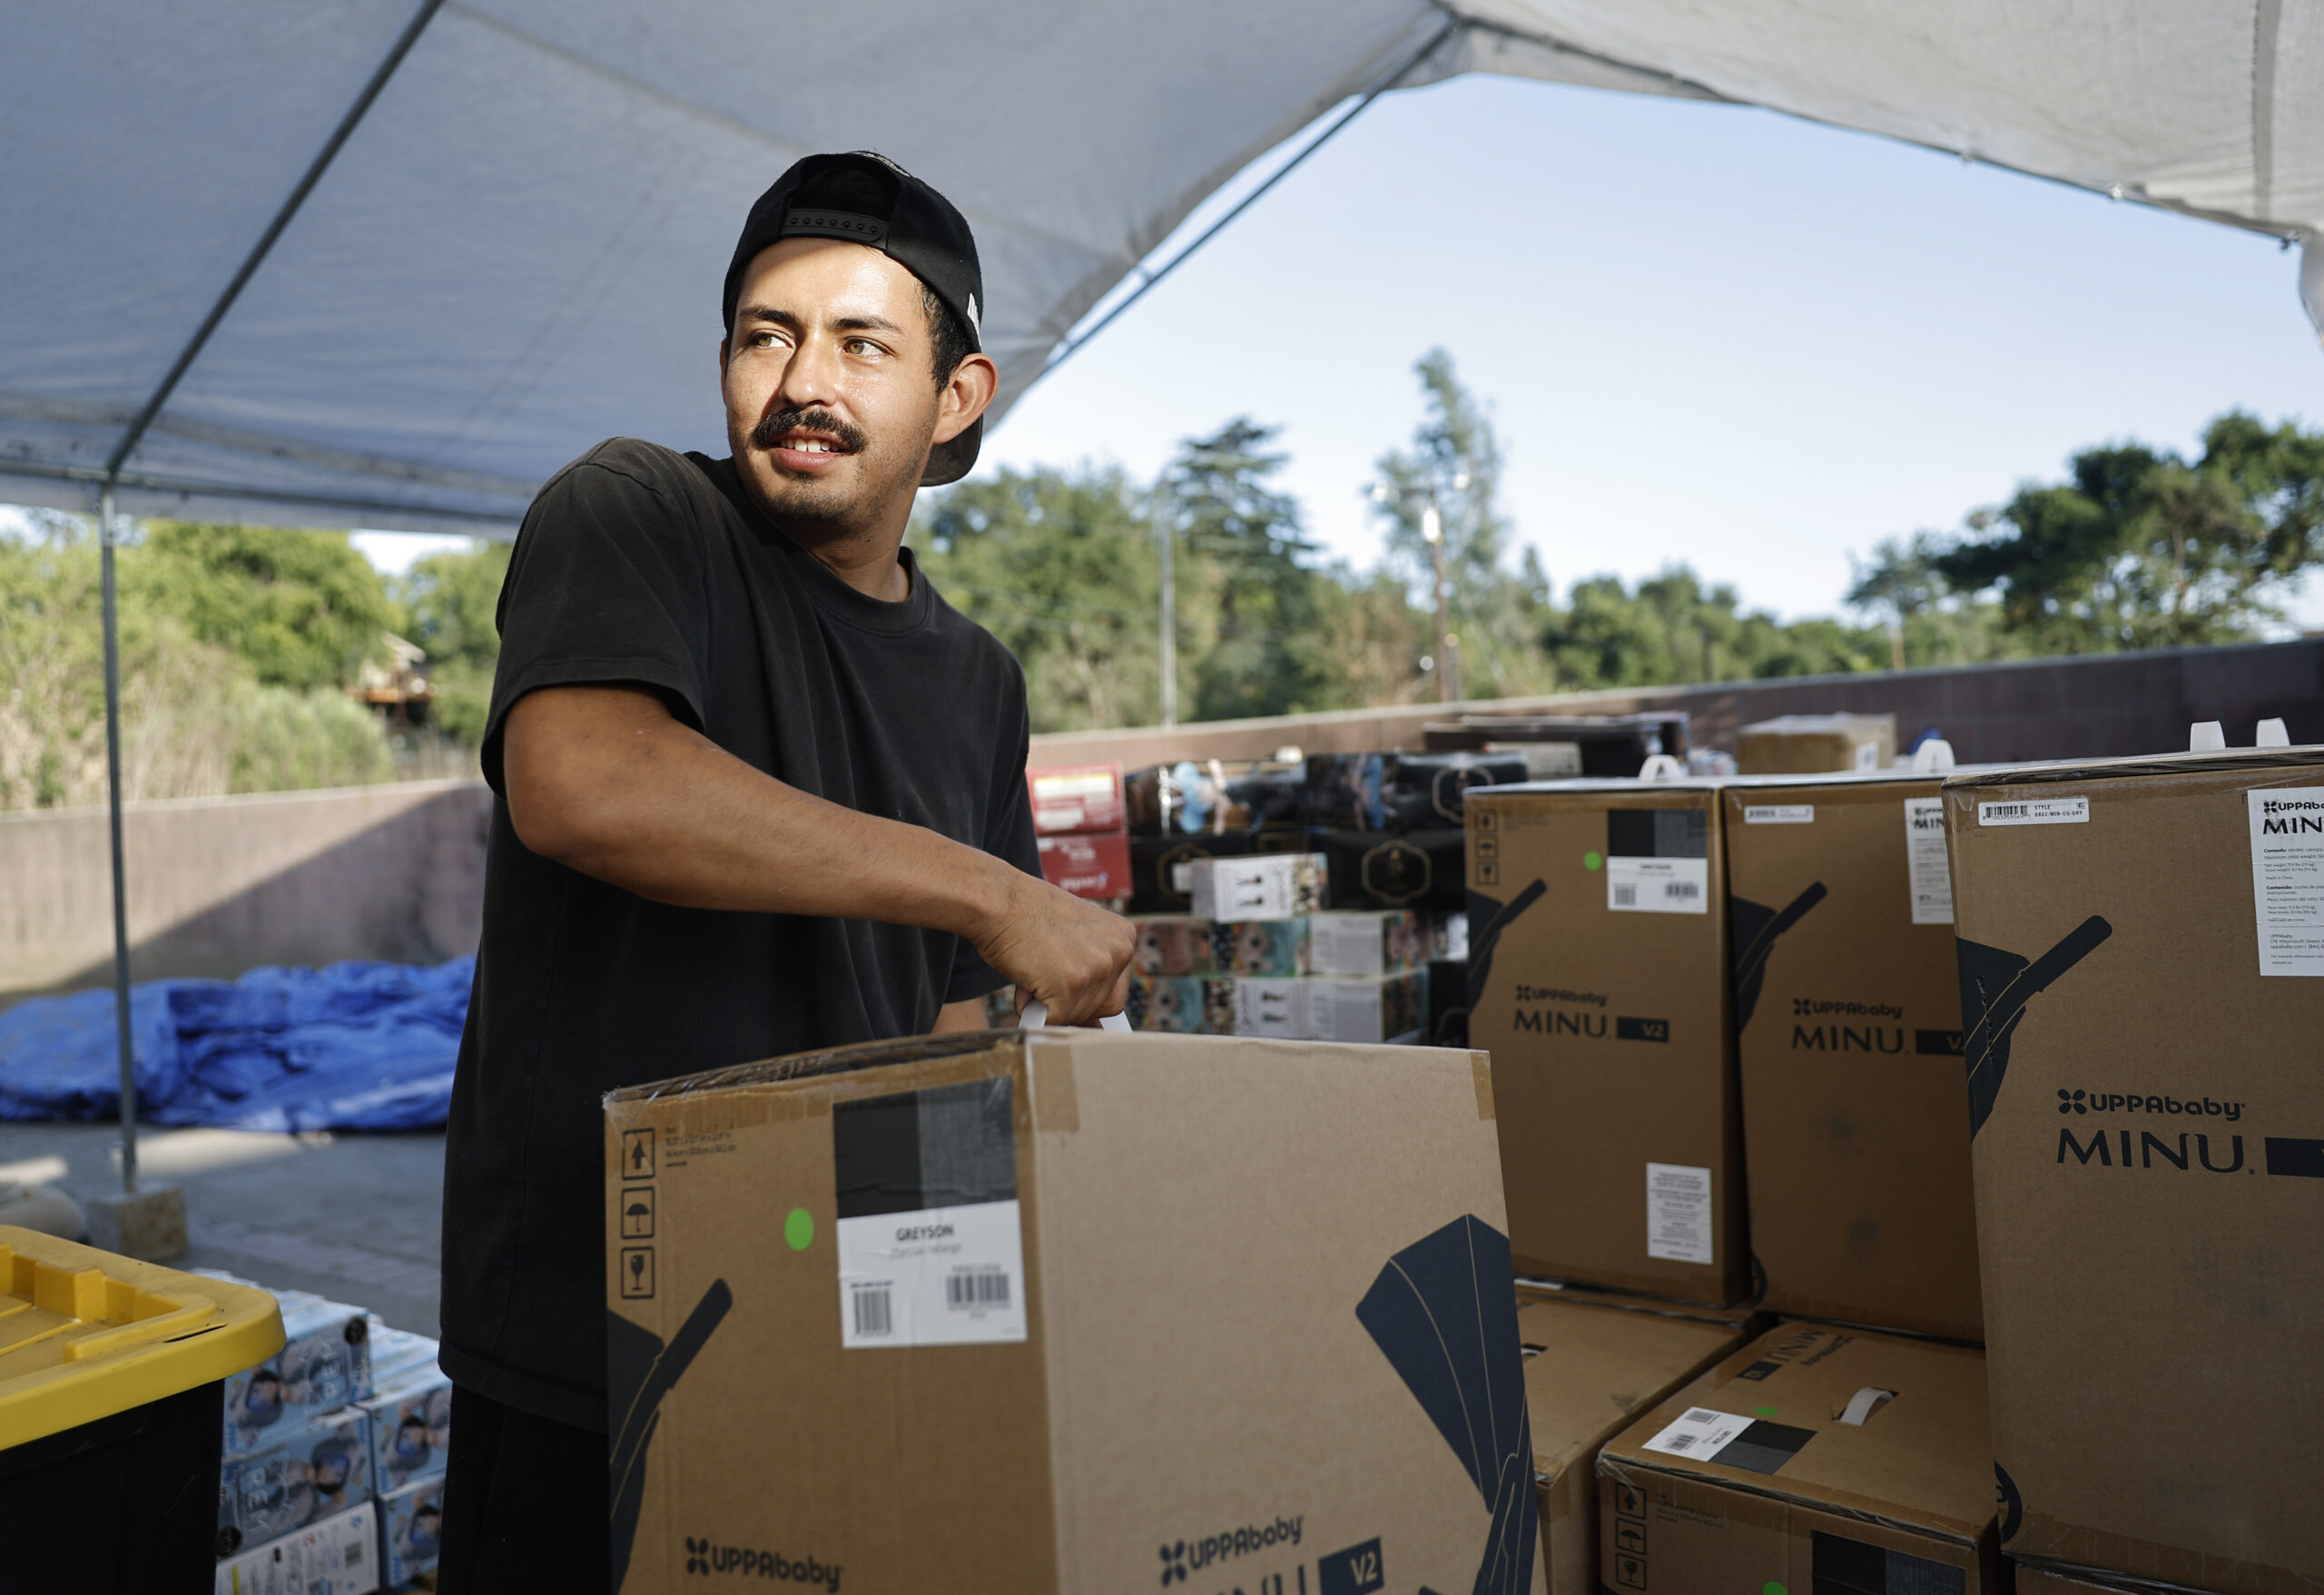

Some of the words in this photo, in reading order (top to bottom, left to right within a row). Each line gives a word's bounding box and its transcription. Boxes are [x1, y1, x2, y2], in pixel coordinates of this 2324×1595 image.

[1513, 1009, 1607, 1039] MINU
[1640, 1023, 1665, 1039] V2
[1813, 1000, 1905, 1019] UPPAbaby
[1792, 1025, 1904, 1055] MINU
[2091, 1093, 2243, 1122] UPPAbaby
[2057, 1127, 2244, 1174] MINU
[895, 1223, 955, 1241] GREYSON
[1189, 1515, 1304, 1570] UPPAbaby
[712, 1545, 842, 1594] UPPAbaby
[1350, 1551, 1377, 1585] V2
